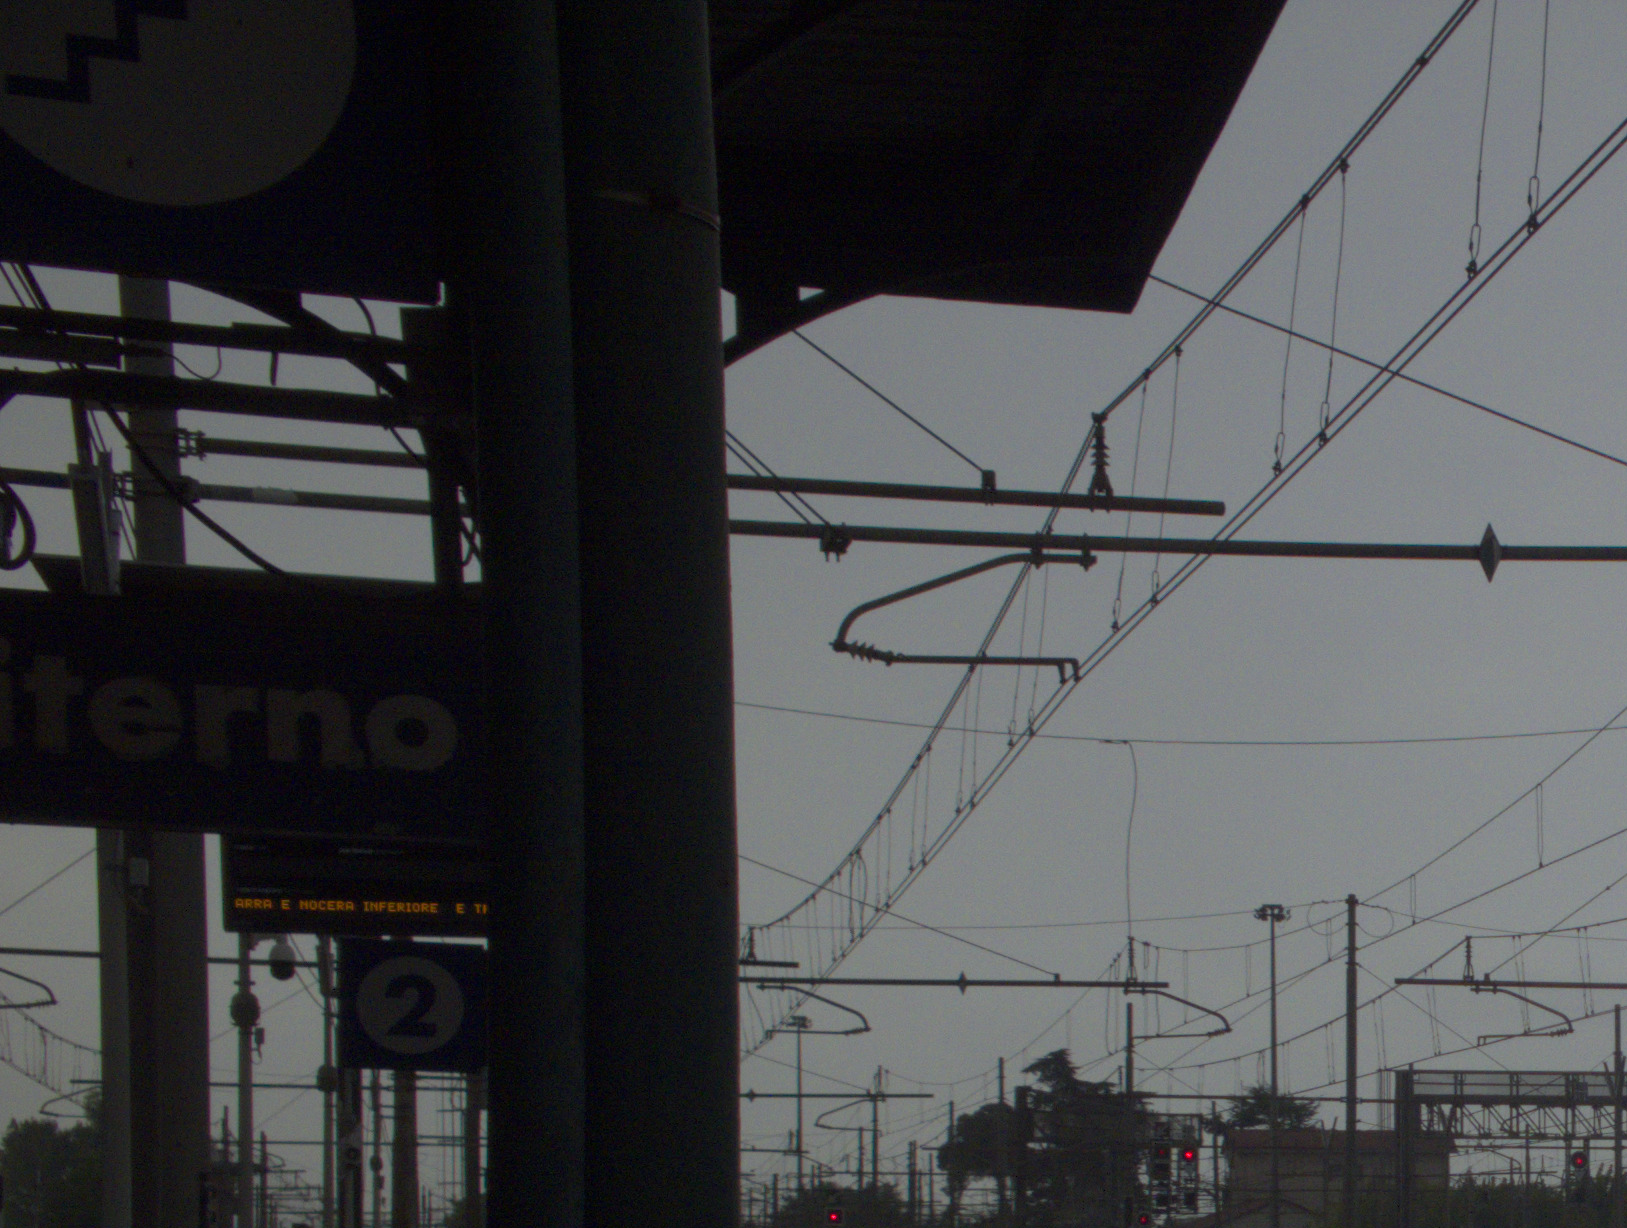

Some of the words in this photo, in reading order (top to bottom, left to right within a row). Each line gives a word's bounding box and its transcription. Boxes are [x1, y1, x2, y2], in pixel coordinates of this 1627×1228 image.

[281, 899, 290, 911] E
[299, 900, 355, 911] NOCERA
[363, 901, 438, 914] INFERIORE
[456, 903, 465, 914] E
[385, 974, 438, 1037] 2
